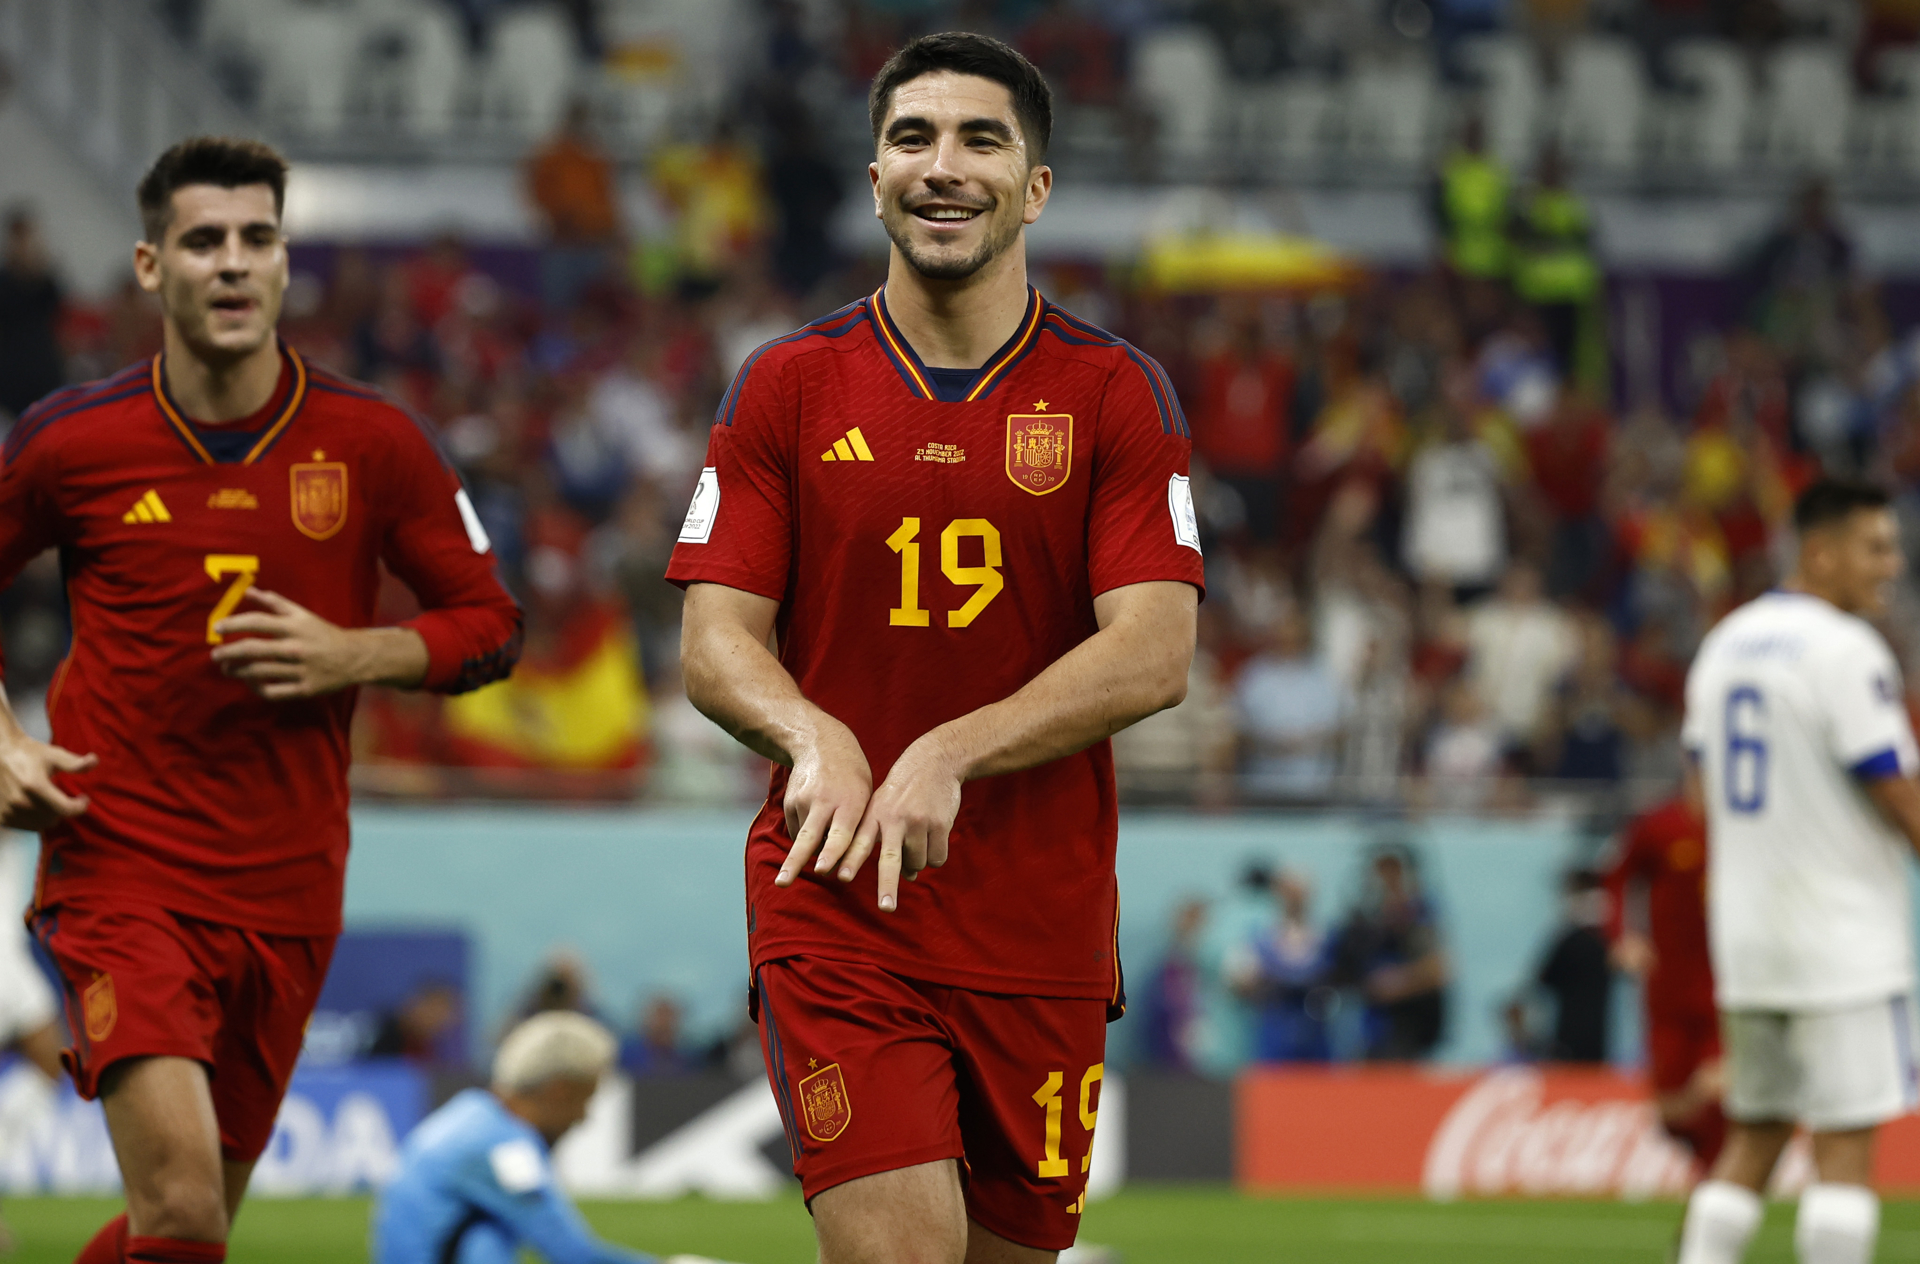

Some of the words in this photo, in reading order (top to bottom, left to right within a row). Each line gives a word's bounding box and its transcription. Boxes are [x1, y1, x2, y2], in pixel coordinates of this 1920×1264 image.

[926, 449, 952, 457] NOVEMBER
[204, 553, 260, 645] 7
[885, 517, 1004, 628] 19
[1724, 684, 1770, 816] 6
